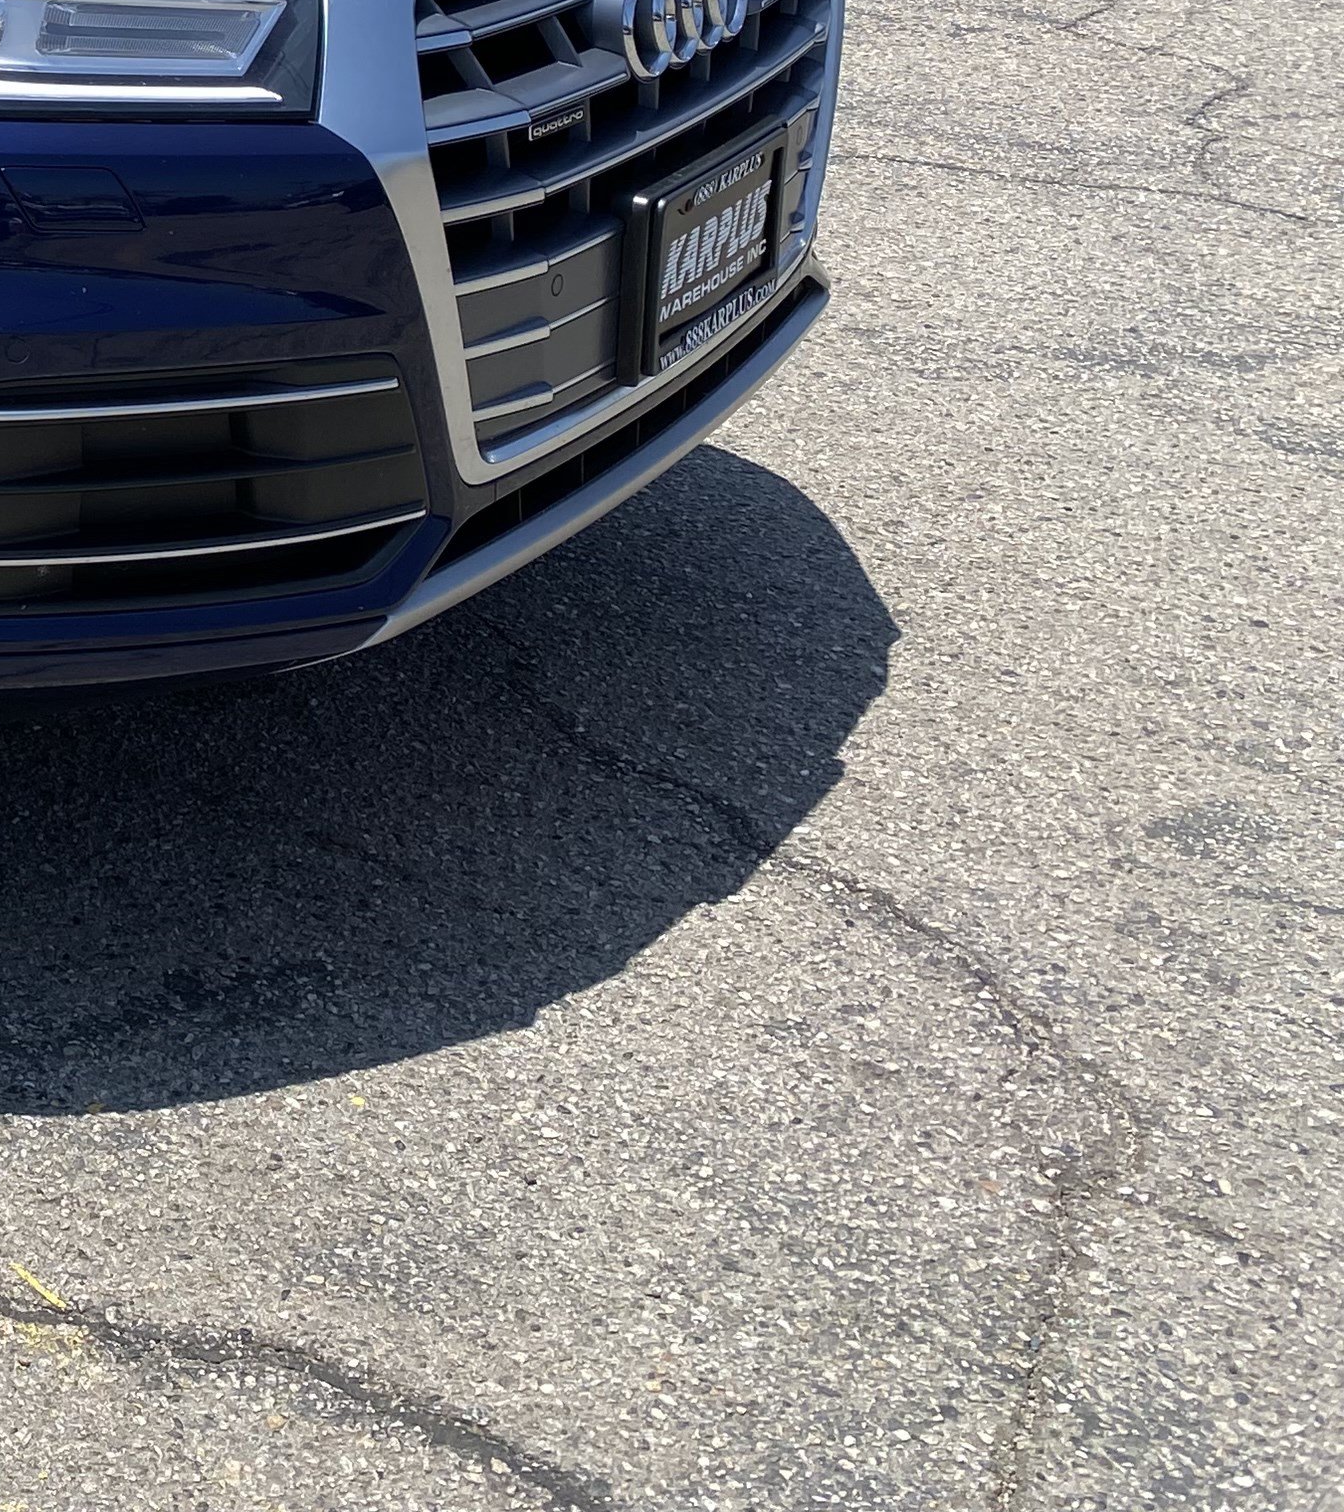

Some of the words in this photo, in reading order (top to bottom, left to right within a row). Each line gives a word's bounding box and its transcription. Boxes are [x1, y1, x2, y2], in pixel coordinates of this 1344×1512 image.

[533, 110, 584, 137] quattro
[718, 151, 765, 193] KARPLUS
[661, 179, 773, 300] KARPLUS
[659, 255, 744, 323] WAREHOUSE
[746, 238, 768, 265] INC
